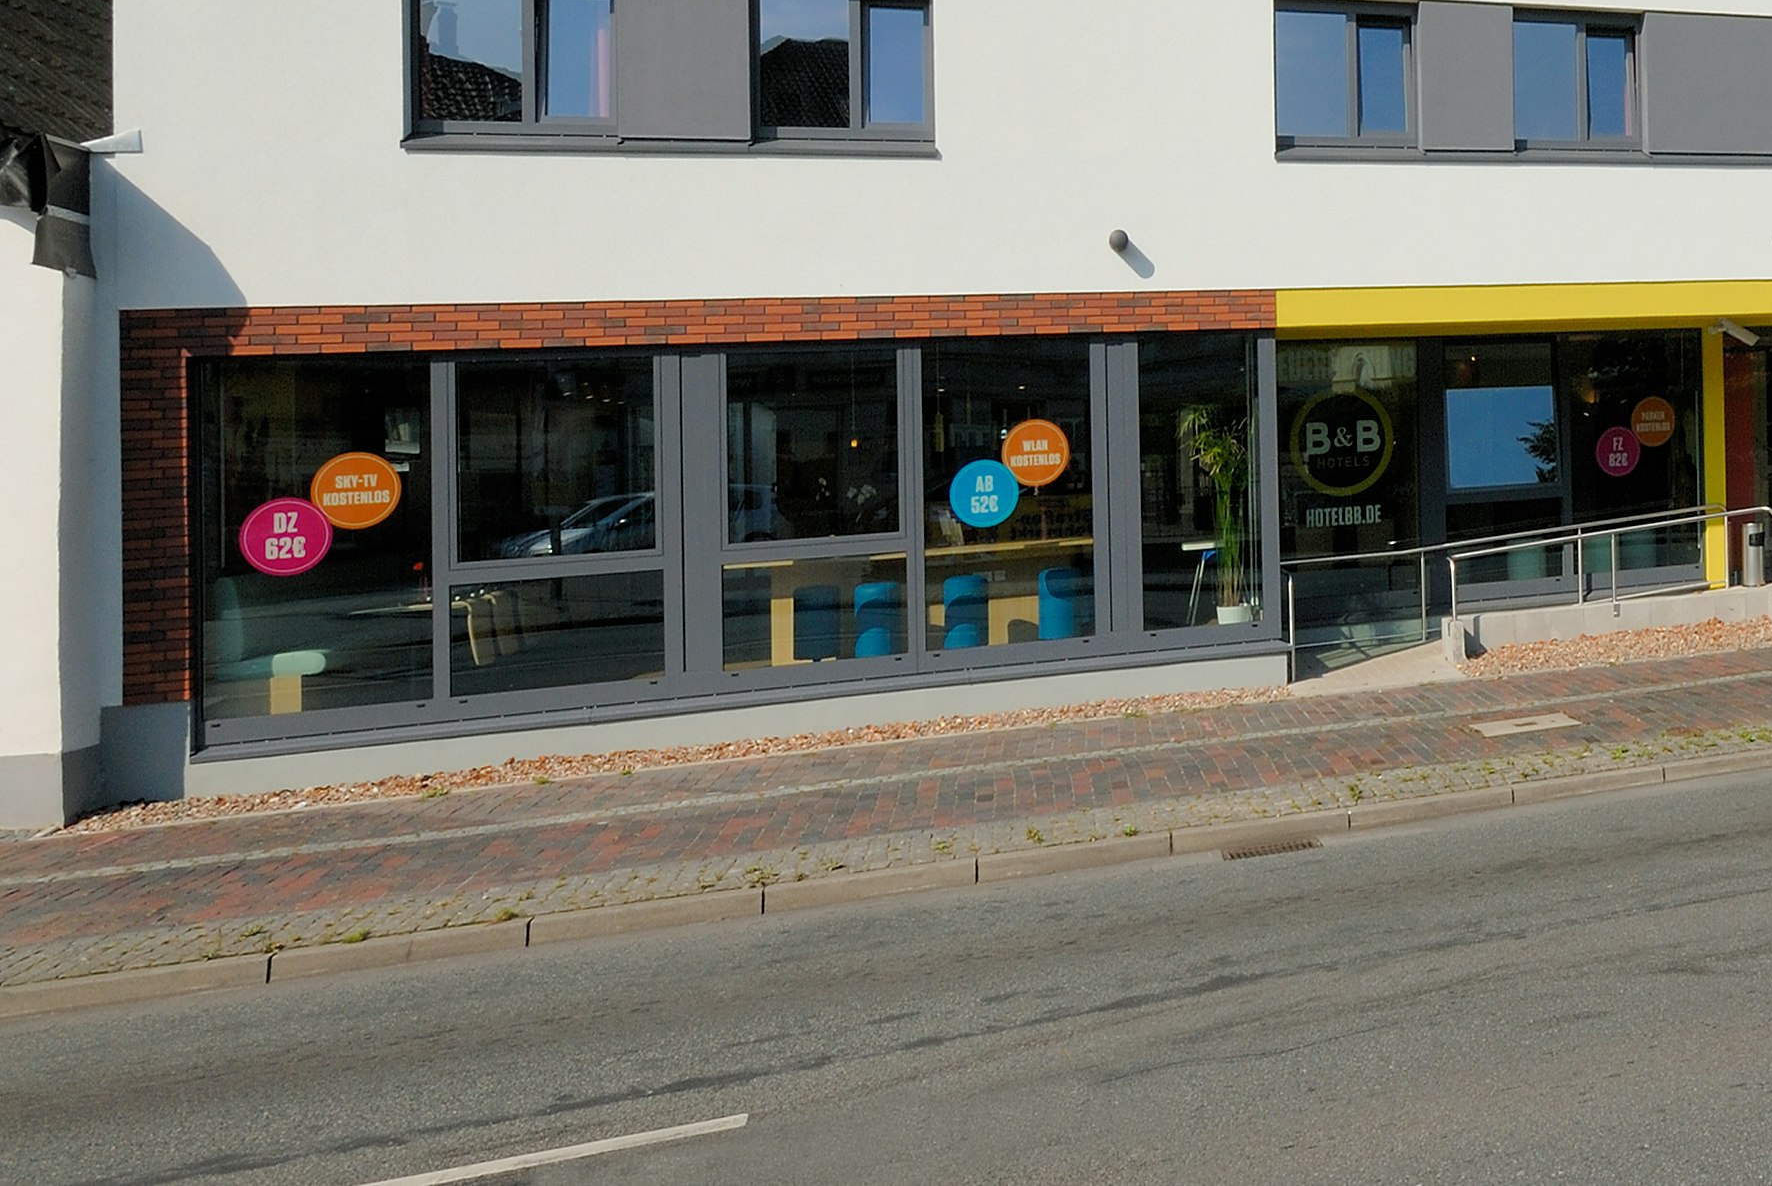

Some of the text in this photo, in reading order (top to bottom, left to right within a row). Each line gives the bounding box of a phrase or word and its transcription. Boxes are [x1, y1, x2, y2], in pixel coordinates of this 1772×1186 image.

[1022, 439, 1048, 452] WLAN
[1306, 419, 1381, 455] B&B
[1010, 453, 1061, 467] KOSTENLOS
[1316, 455, 1370, 469] HOTELS
[335, 474, 378, 489] SKY-TV
[975, 475, 994, 493] AB
[323, 490, 390, 506] KOSTENLOS
[273, 512, 298, 534] DZ
[1306, 504, 1381, 528] HOTELBB.DE
[265, 536, 307, 560] 62€
